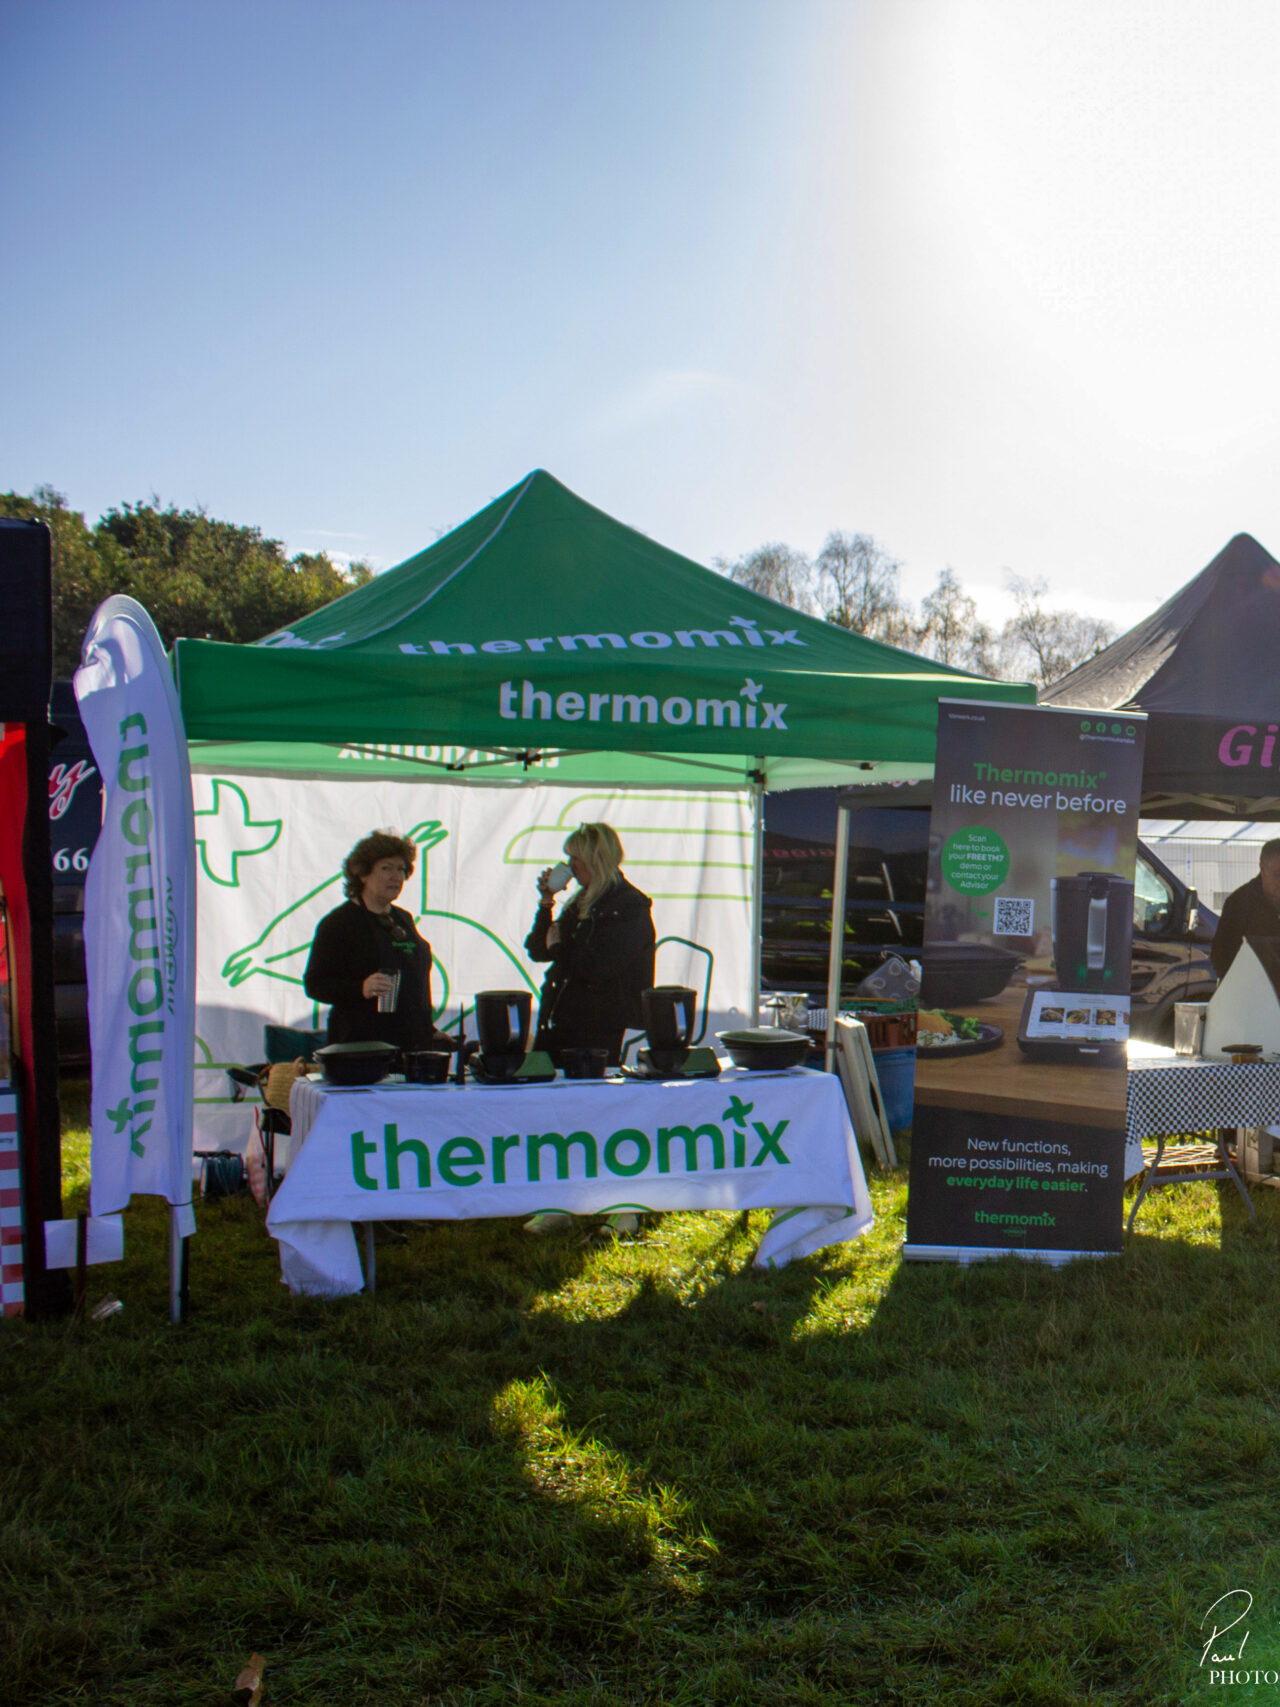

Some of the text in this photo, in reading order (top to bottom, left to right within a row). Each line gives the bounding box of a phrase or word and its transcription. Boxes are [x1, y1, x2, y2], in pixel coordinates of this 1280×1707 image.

[398, 616, 808, 655] thermomix
[499, 678, 788, 730] thermomix
[950, 784, 1127, 814] like never before
[968, 834, 987, 842] Scan
[953, 843, 970, 851] here
[981, 844, 1000, 852] book
[948, 853, 966, 861] your
[967, 853, 987, 861] FREE
[960, 862, 982, 870] demo
[951, 871, 998, 881] contact your
[960, 880, 989, 888] Advisor
[350, 1095, 790, 1190] thermomix
[968, 1138, 1071, 1156] New functions,
[928, 1156, 1109, 1178] more possibilities, making
[946, 1175, 1088, 1192] everyday life easier.
[974, 1210, 1056, 1227] thermomix
